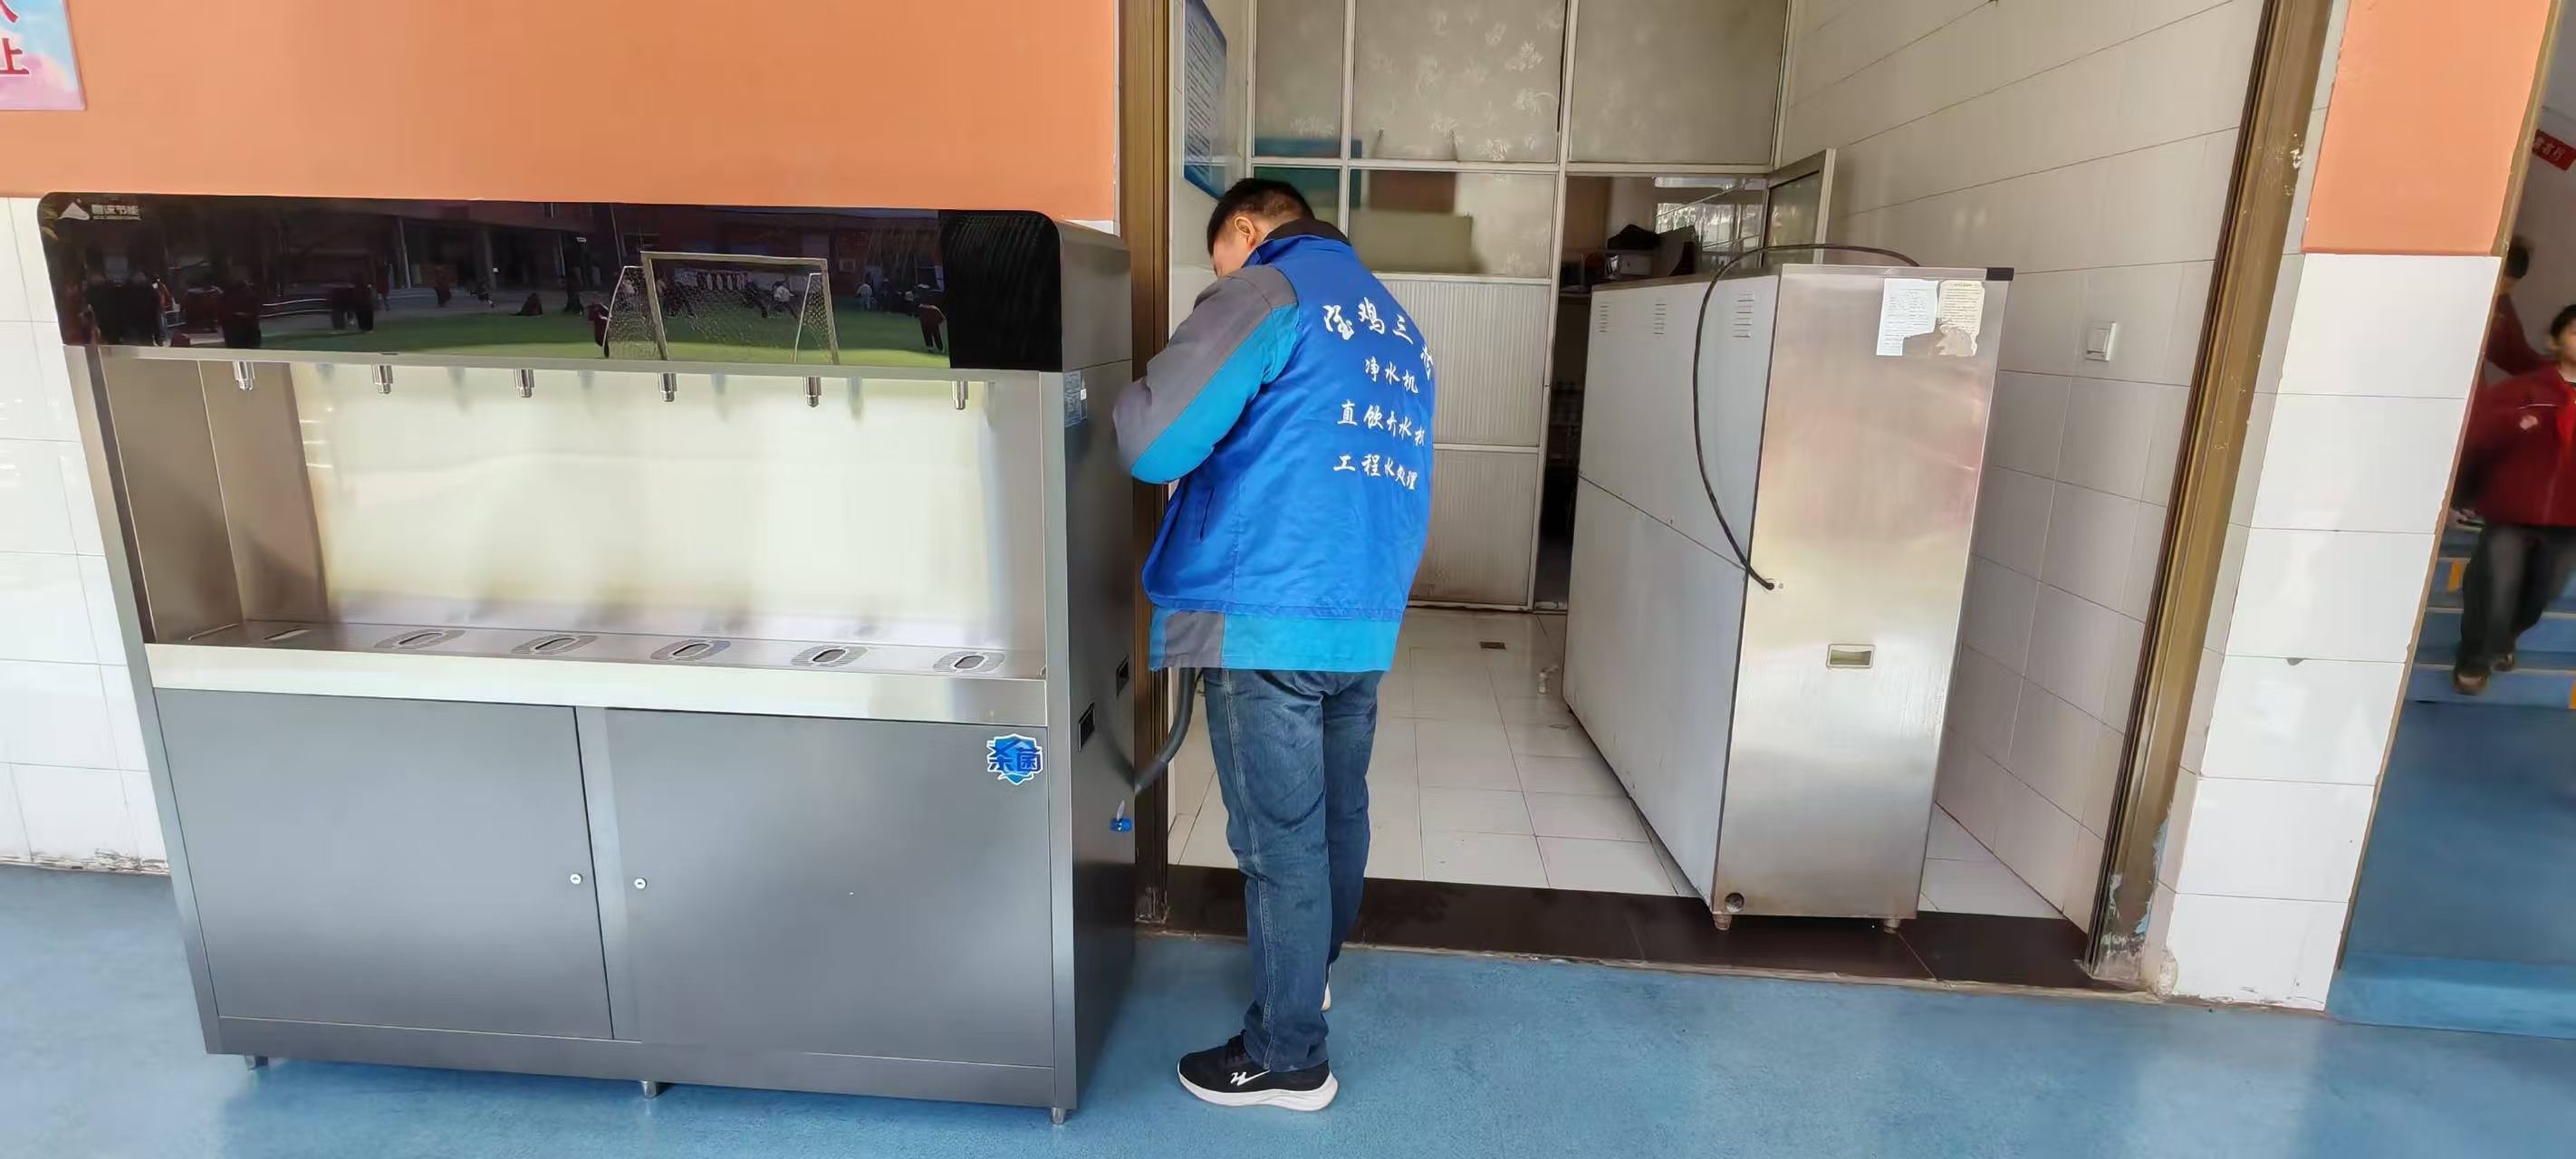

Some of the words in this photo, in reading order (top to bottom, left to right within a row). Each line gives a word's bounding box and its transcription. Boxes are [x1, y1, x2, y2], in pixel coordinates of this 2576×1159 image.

[1364, 356, 1418, 393] 净水机
[1332, 454, 1418, 490] 工程水处理
[988, 737, 1043, 772] 杀菌
